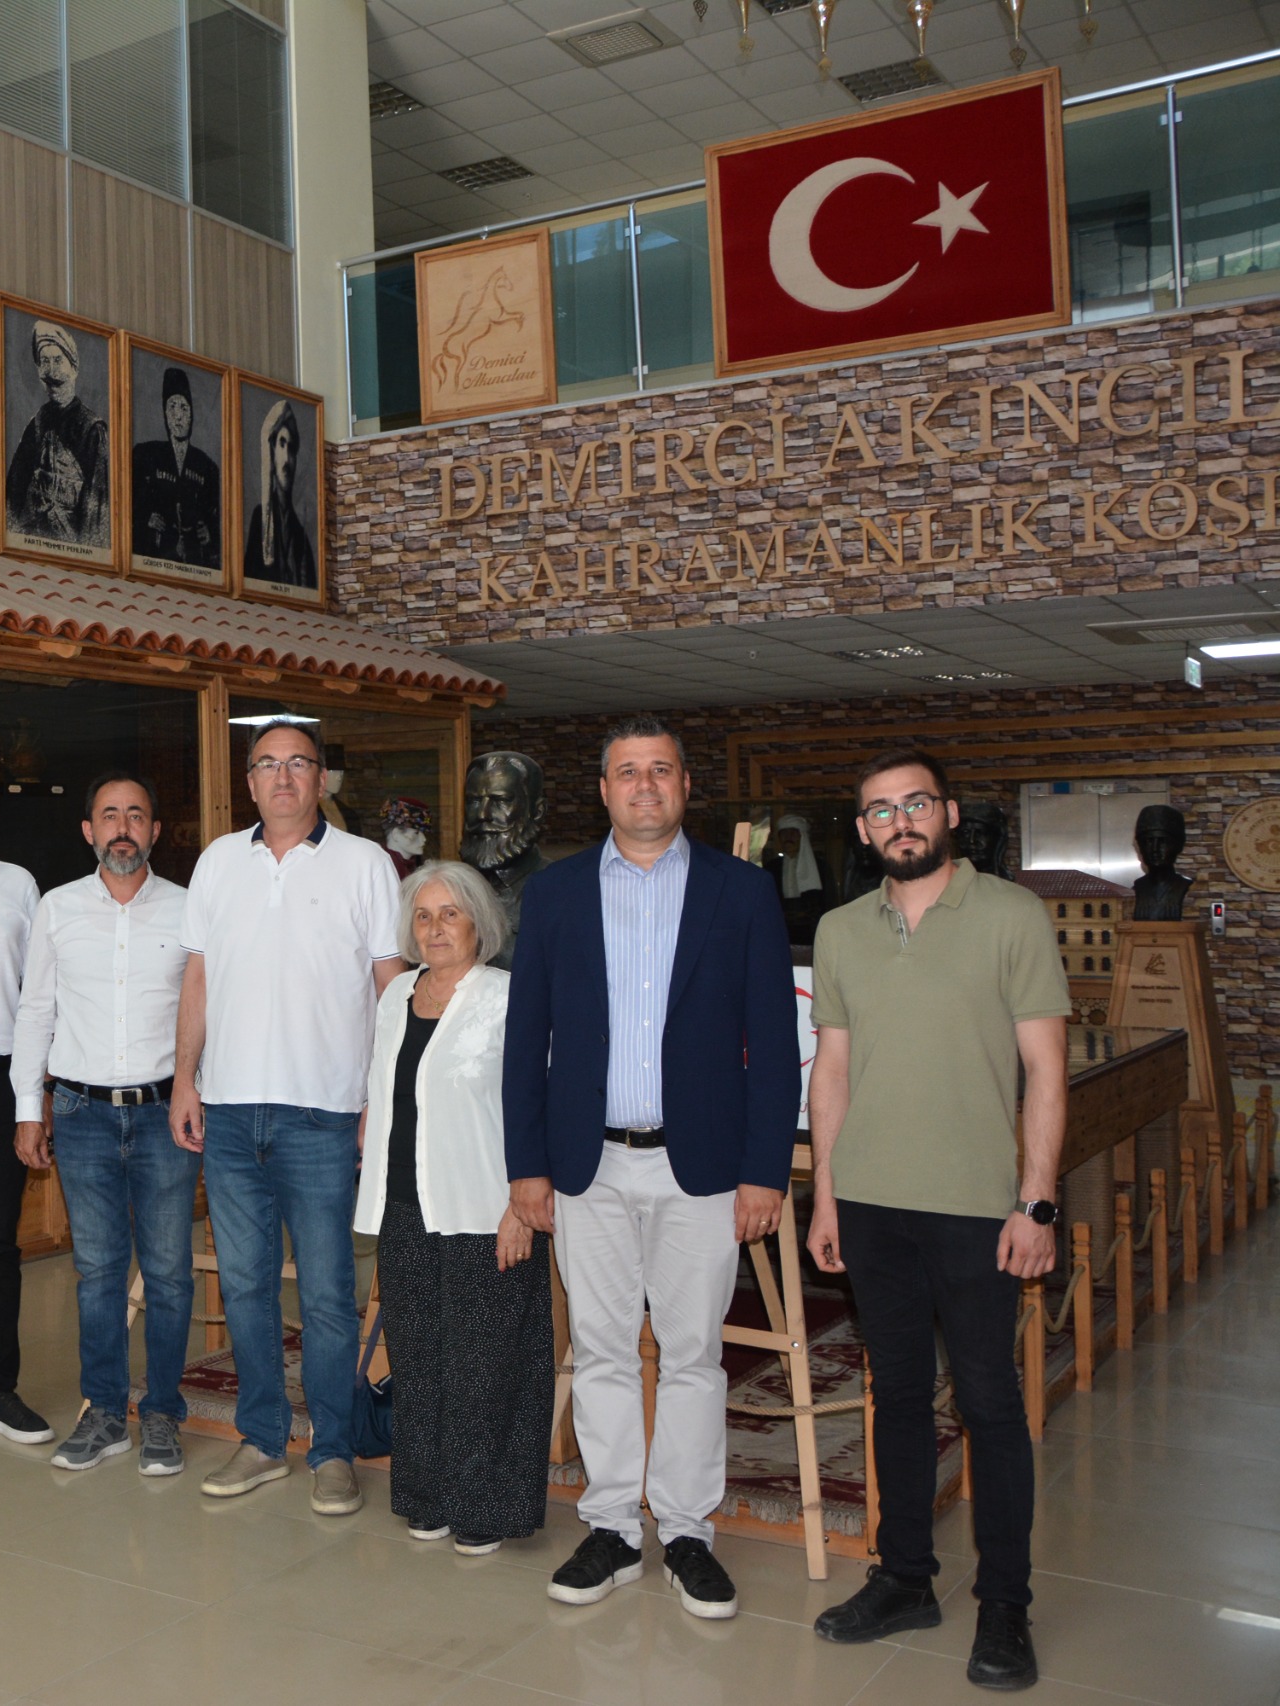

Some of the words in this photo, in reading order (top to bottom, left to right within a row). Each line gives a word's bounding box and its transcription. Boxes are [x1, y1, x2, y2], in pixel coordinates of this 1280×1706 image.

[468, 350, 527, 371] Demirci
[430, 396, 795, 522] DEMİRCİ
[477, 498, 1054, 606] KAHRAMANLIK
